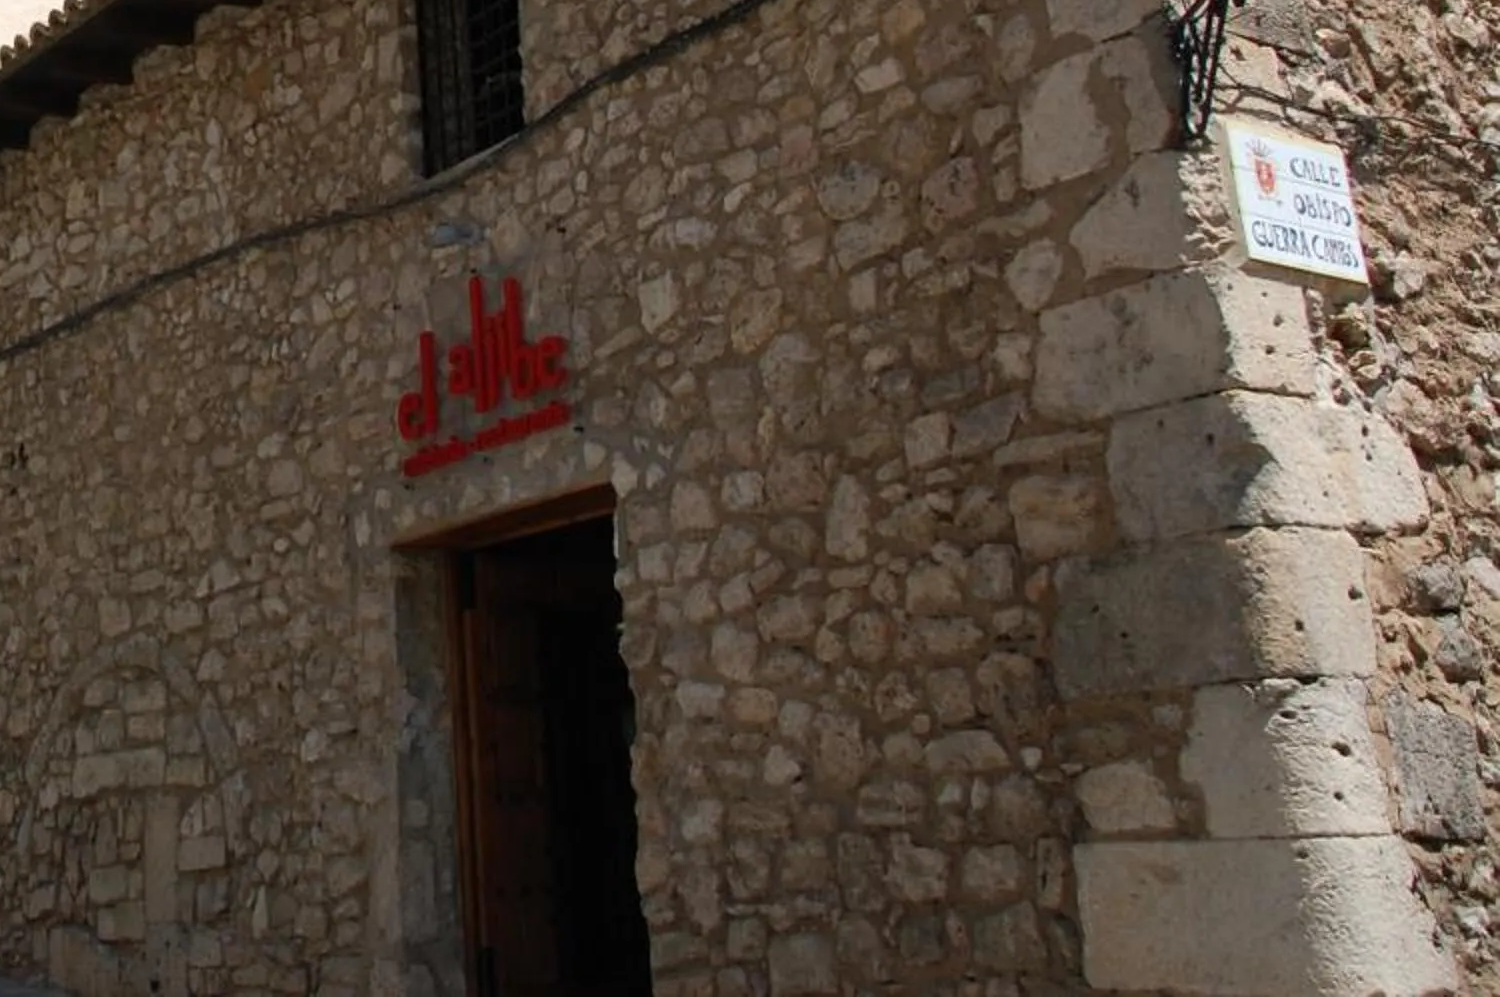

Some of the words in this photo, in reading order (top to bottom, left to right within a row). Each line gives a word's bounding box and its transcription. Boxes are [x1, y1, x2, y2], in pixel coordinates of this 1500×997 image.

[1289, 157, 1341, 187] CALLE
[1294, 192, 1352, 227] OBISPO
[1251, 219, 1311, 259] GUERRA
